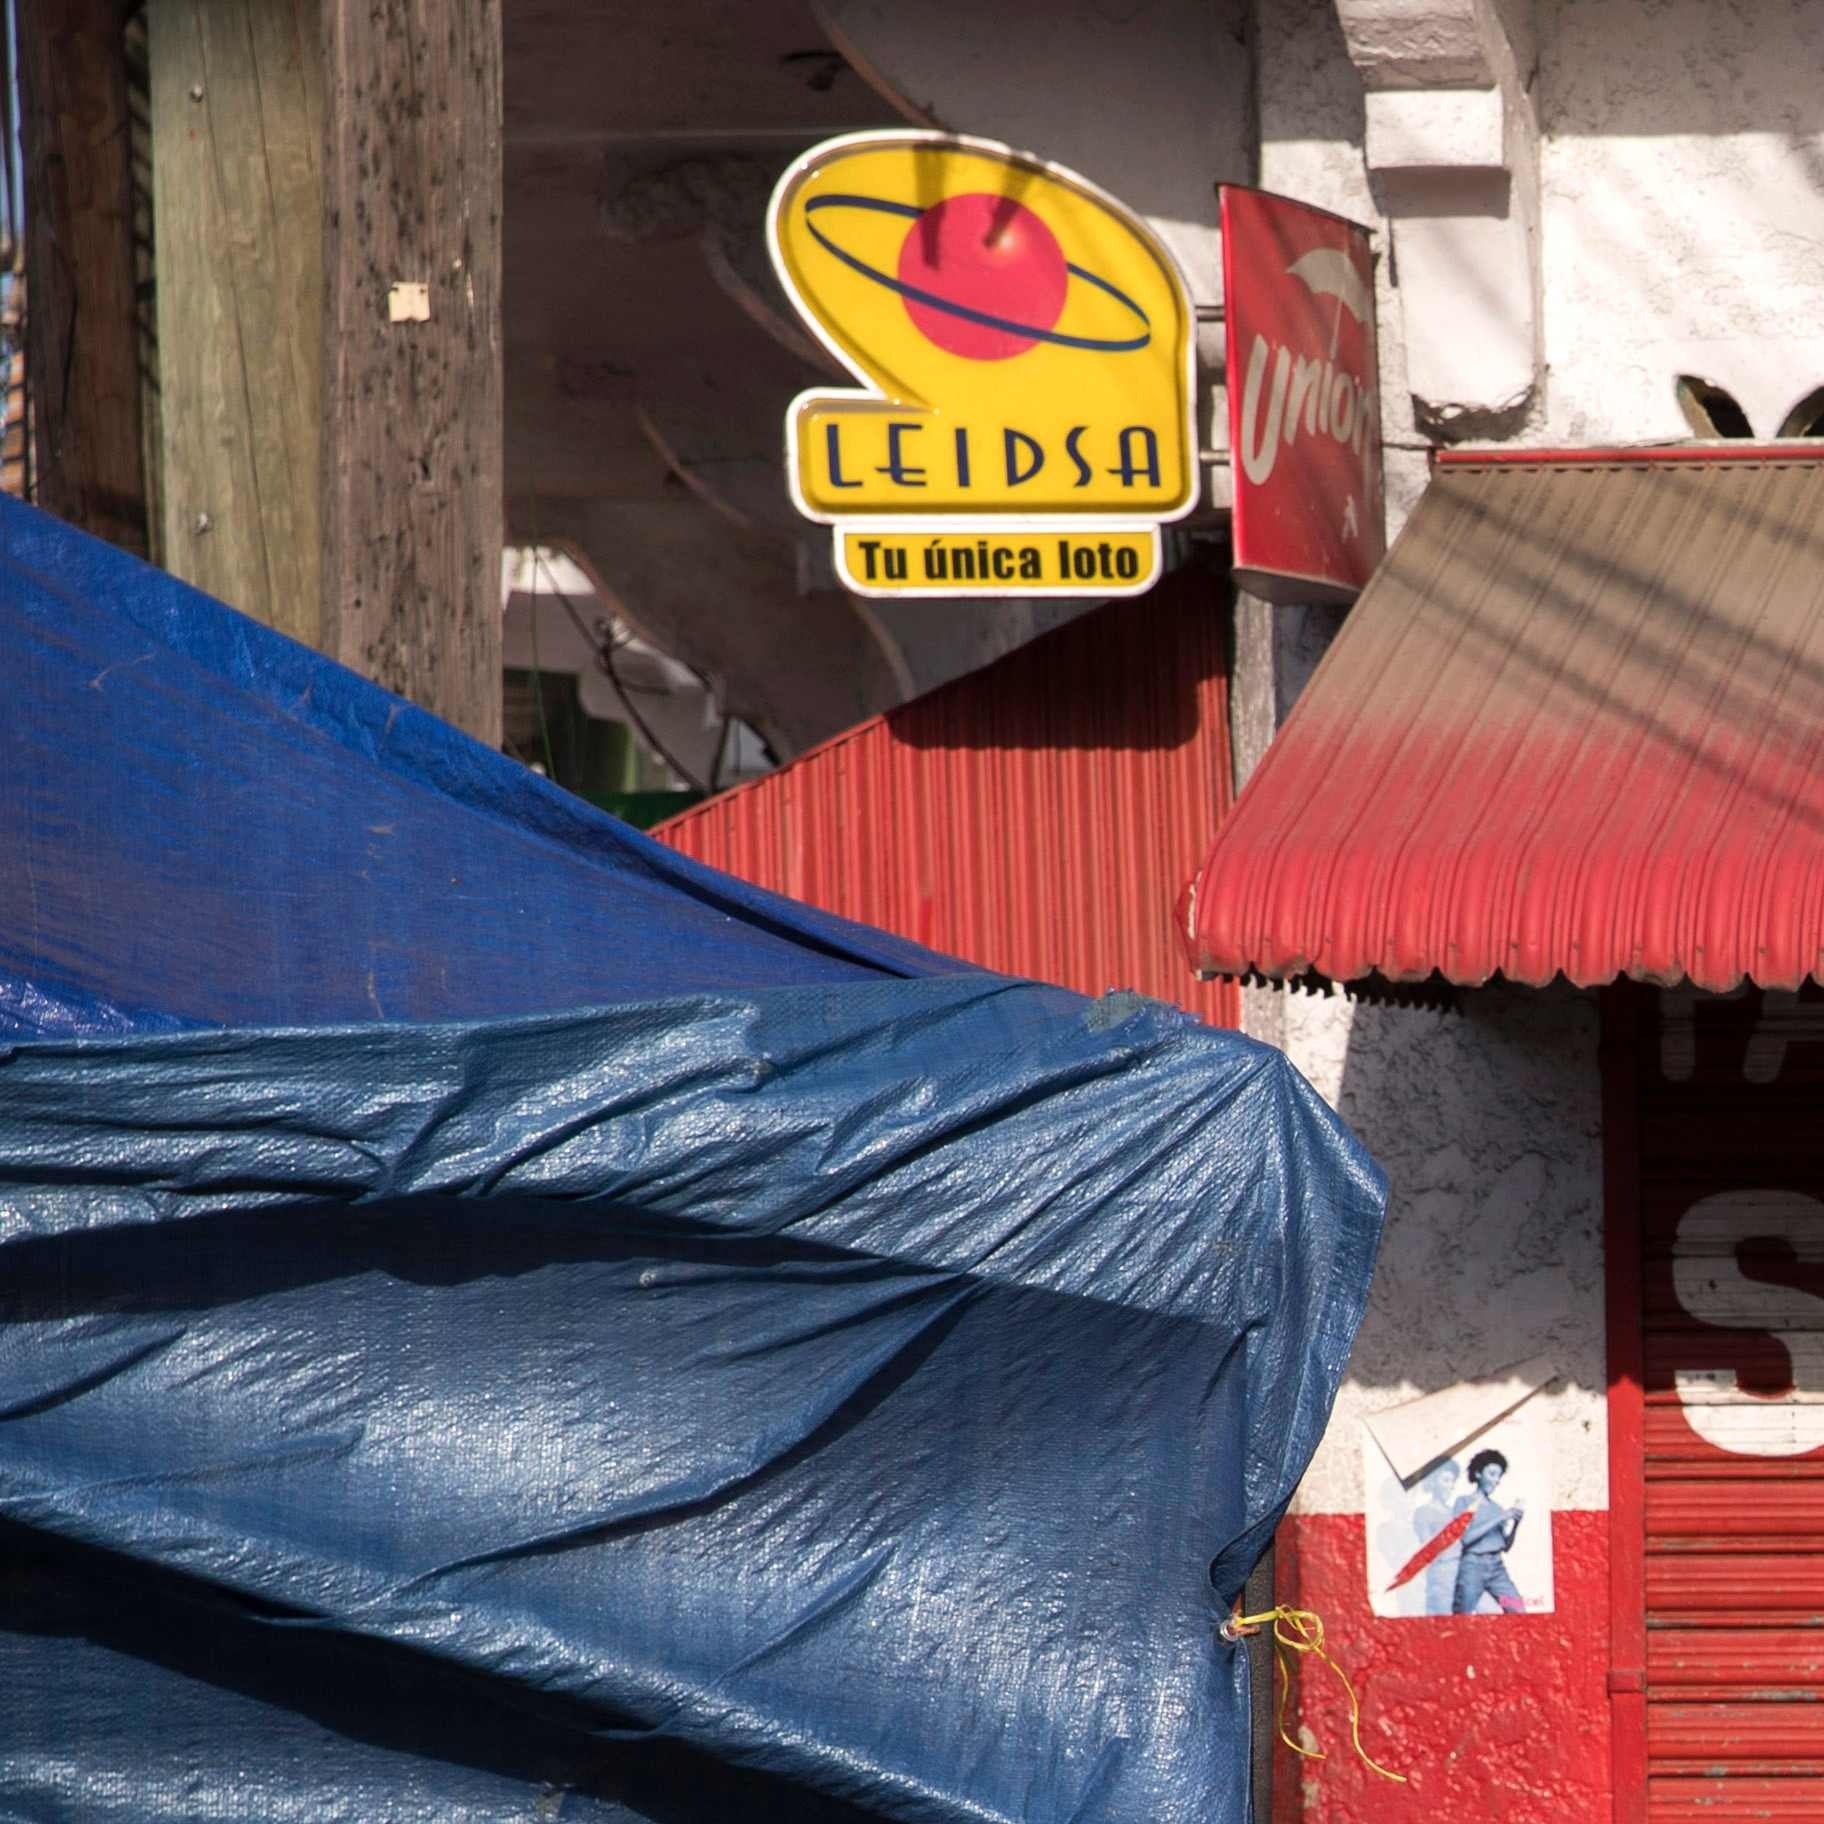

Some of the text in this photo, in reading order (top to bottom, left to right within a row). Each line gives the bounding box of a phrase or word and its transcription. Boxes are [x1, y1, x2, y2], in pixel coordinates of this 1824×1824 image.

[826, 422, 1161, 489] LEIDSA
[858, 538, 1139, 581] Tu única loto
